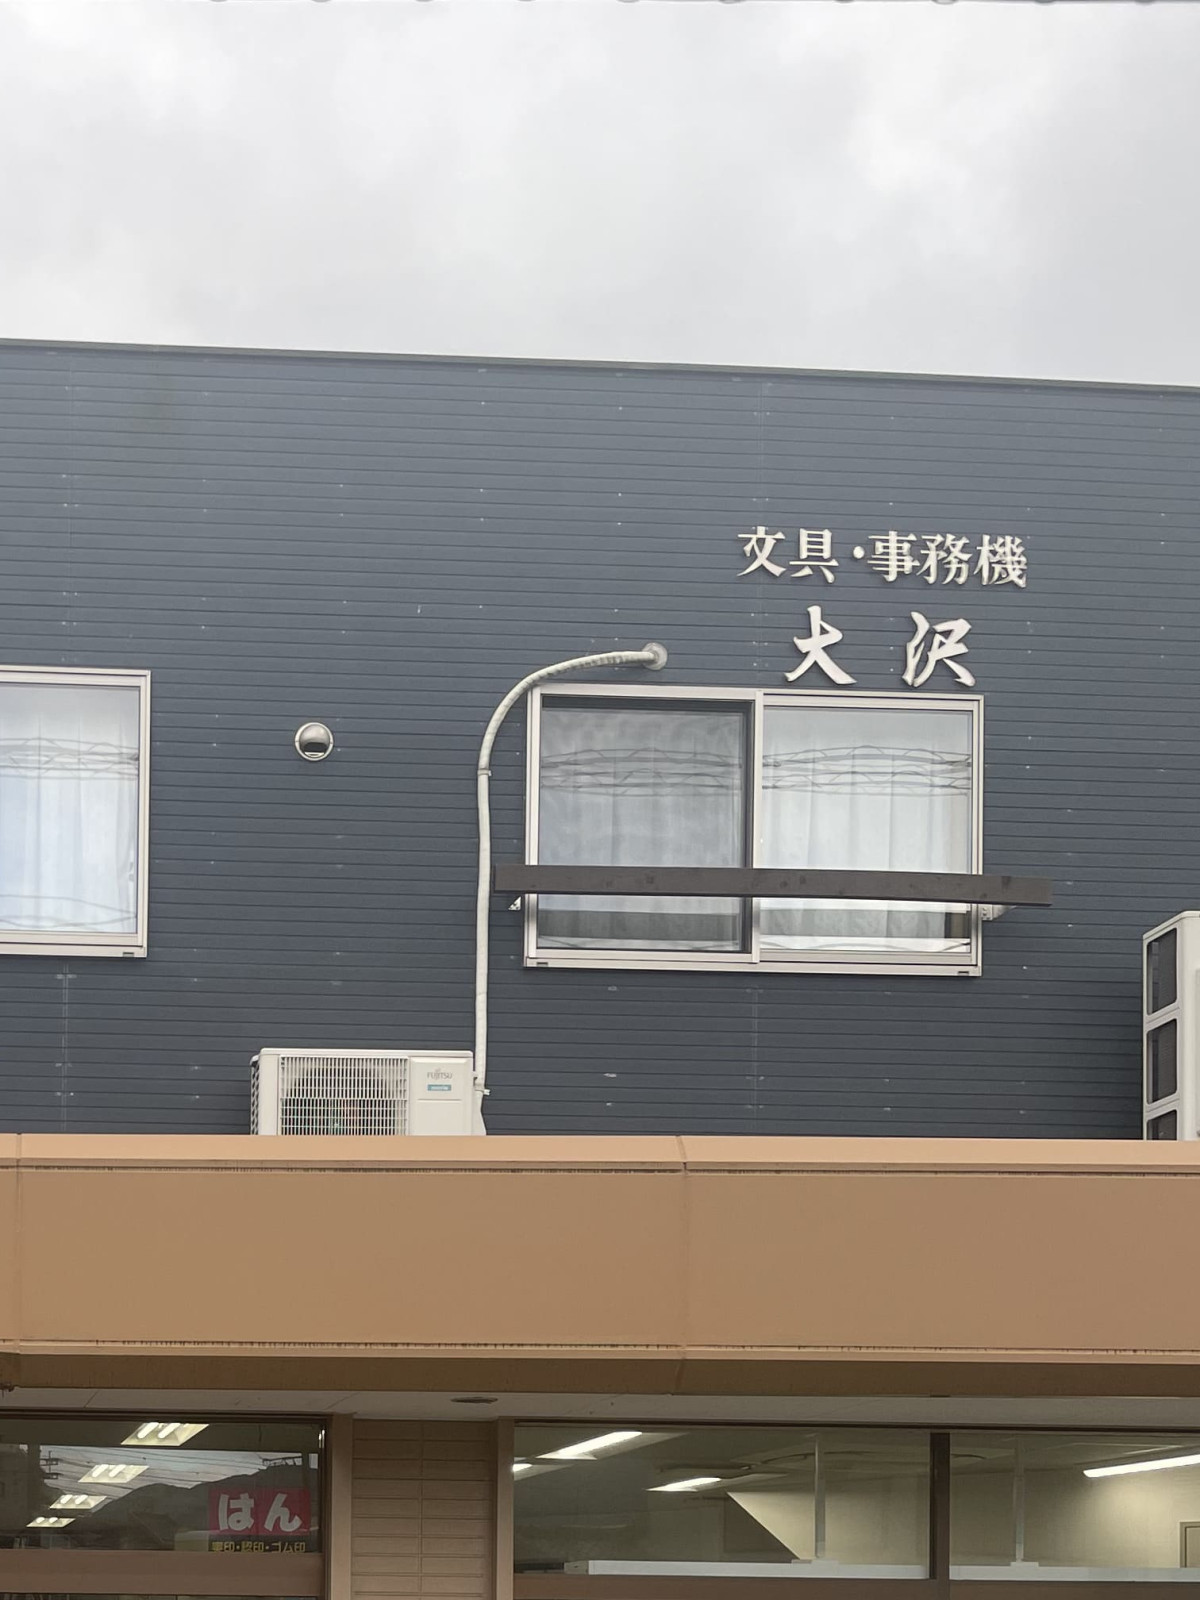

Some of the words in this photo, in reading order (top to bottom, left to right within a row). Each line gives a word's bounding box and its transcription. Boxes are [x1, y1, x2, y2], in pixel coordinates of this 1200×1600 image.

[737, 525, 1028, 588] 文具・事務機
[784, 605, 976, 688] 大沢
[218, 1493, 303, 1532] はん
